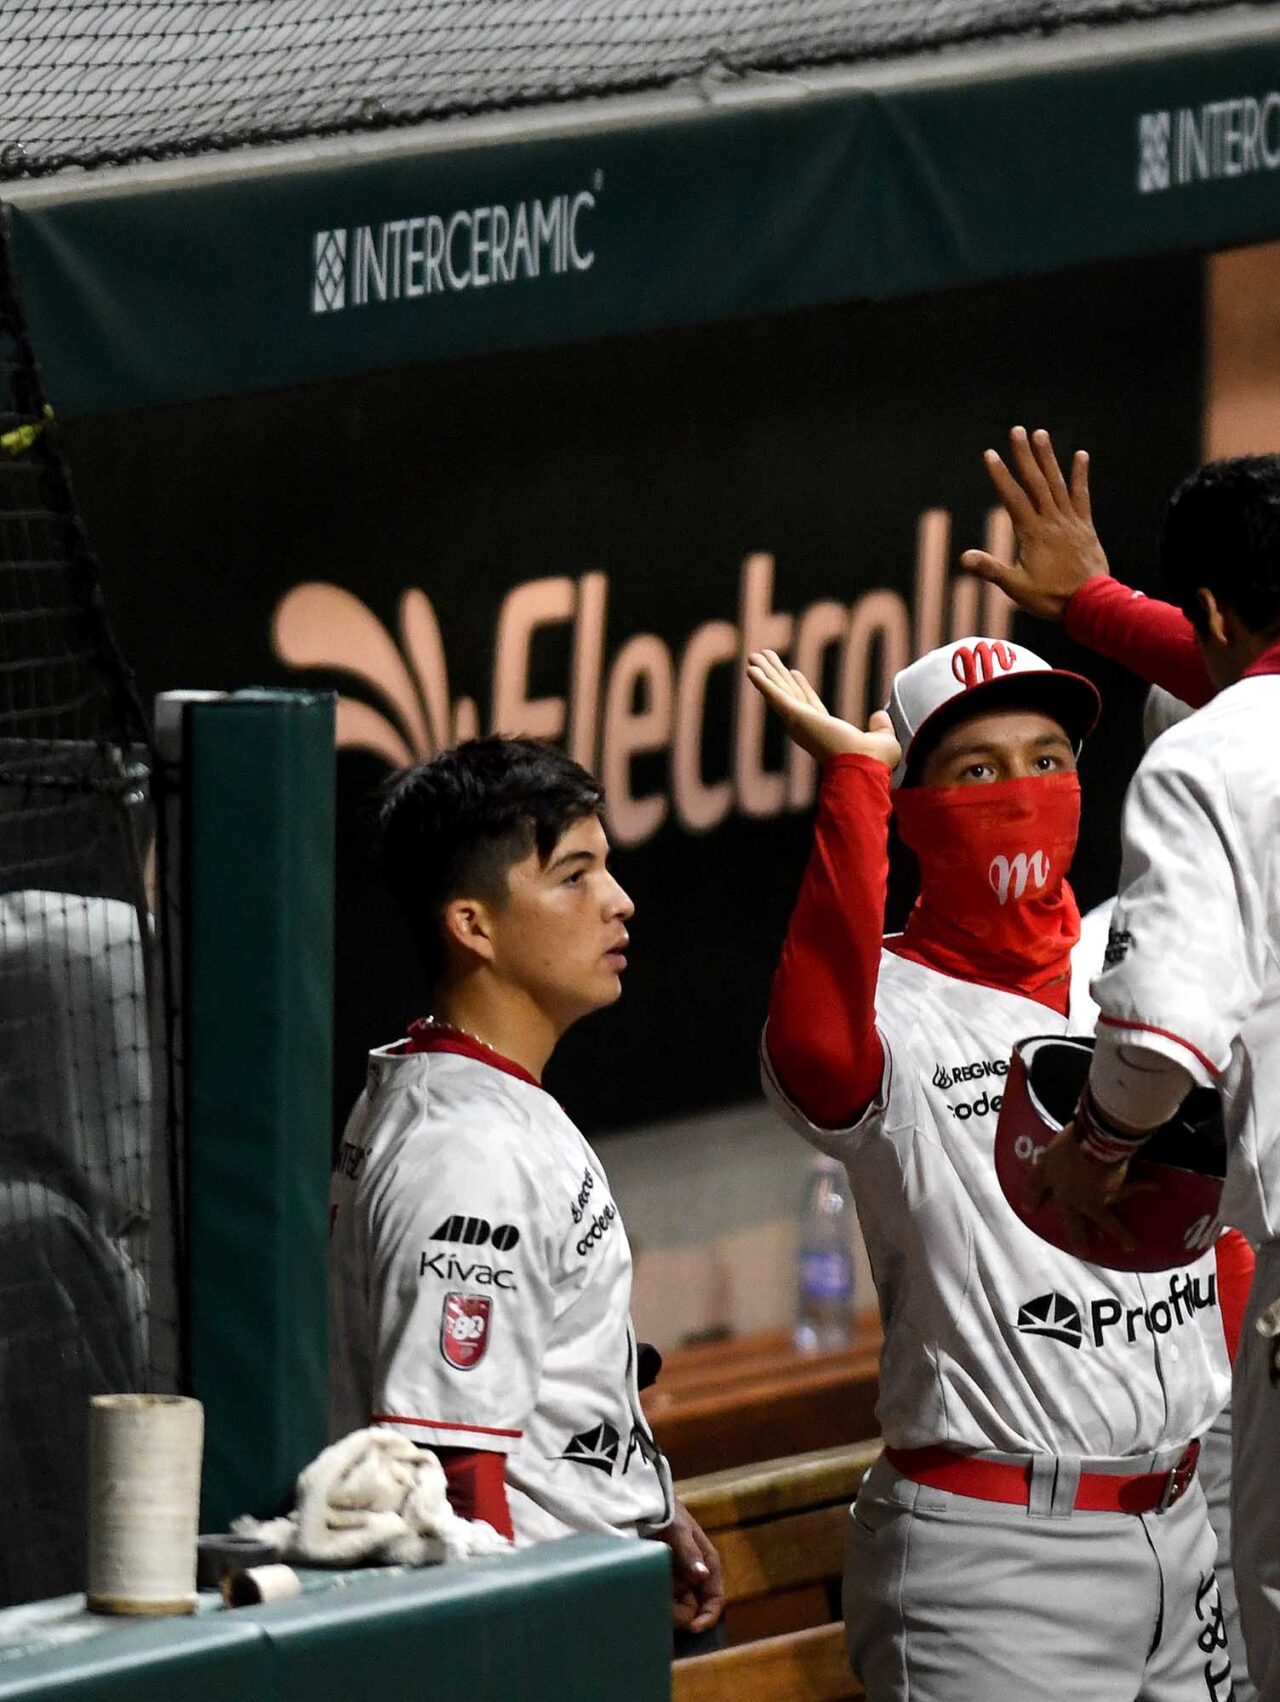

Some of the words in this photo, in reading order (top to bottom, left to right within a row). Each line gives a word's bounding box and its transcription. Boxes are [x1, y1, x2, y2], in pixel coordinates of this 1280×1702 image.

[353, 190, 595, 305] INTERCERAMIC
[490, 505, 1014, 849] Electrol
[429, 1214, 520, 1251] ADO
